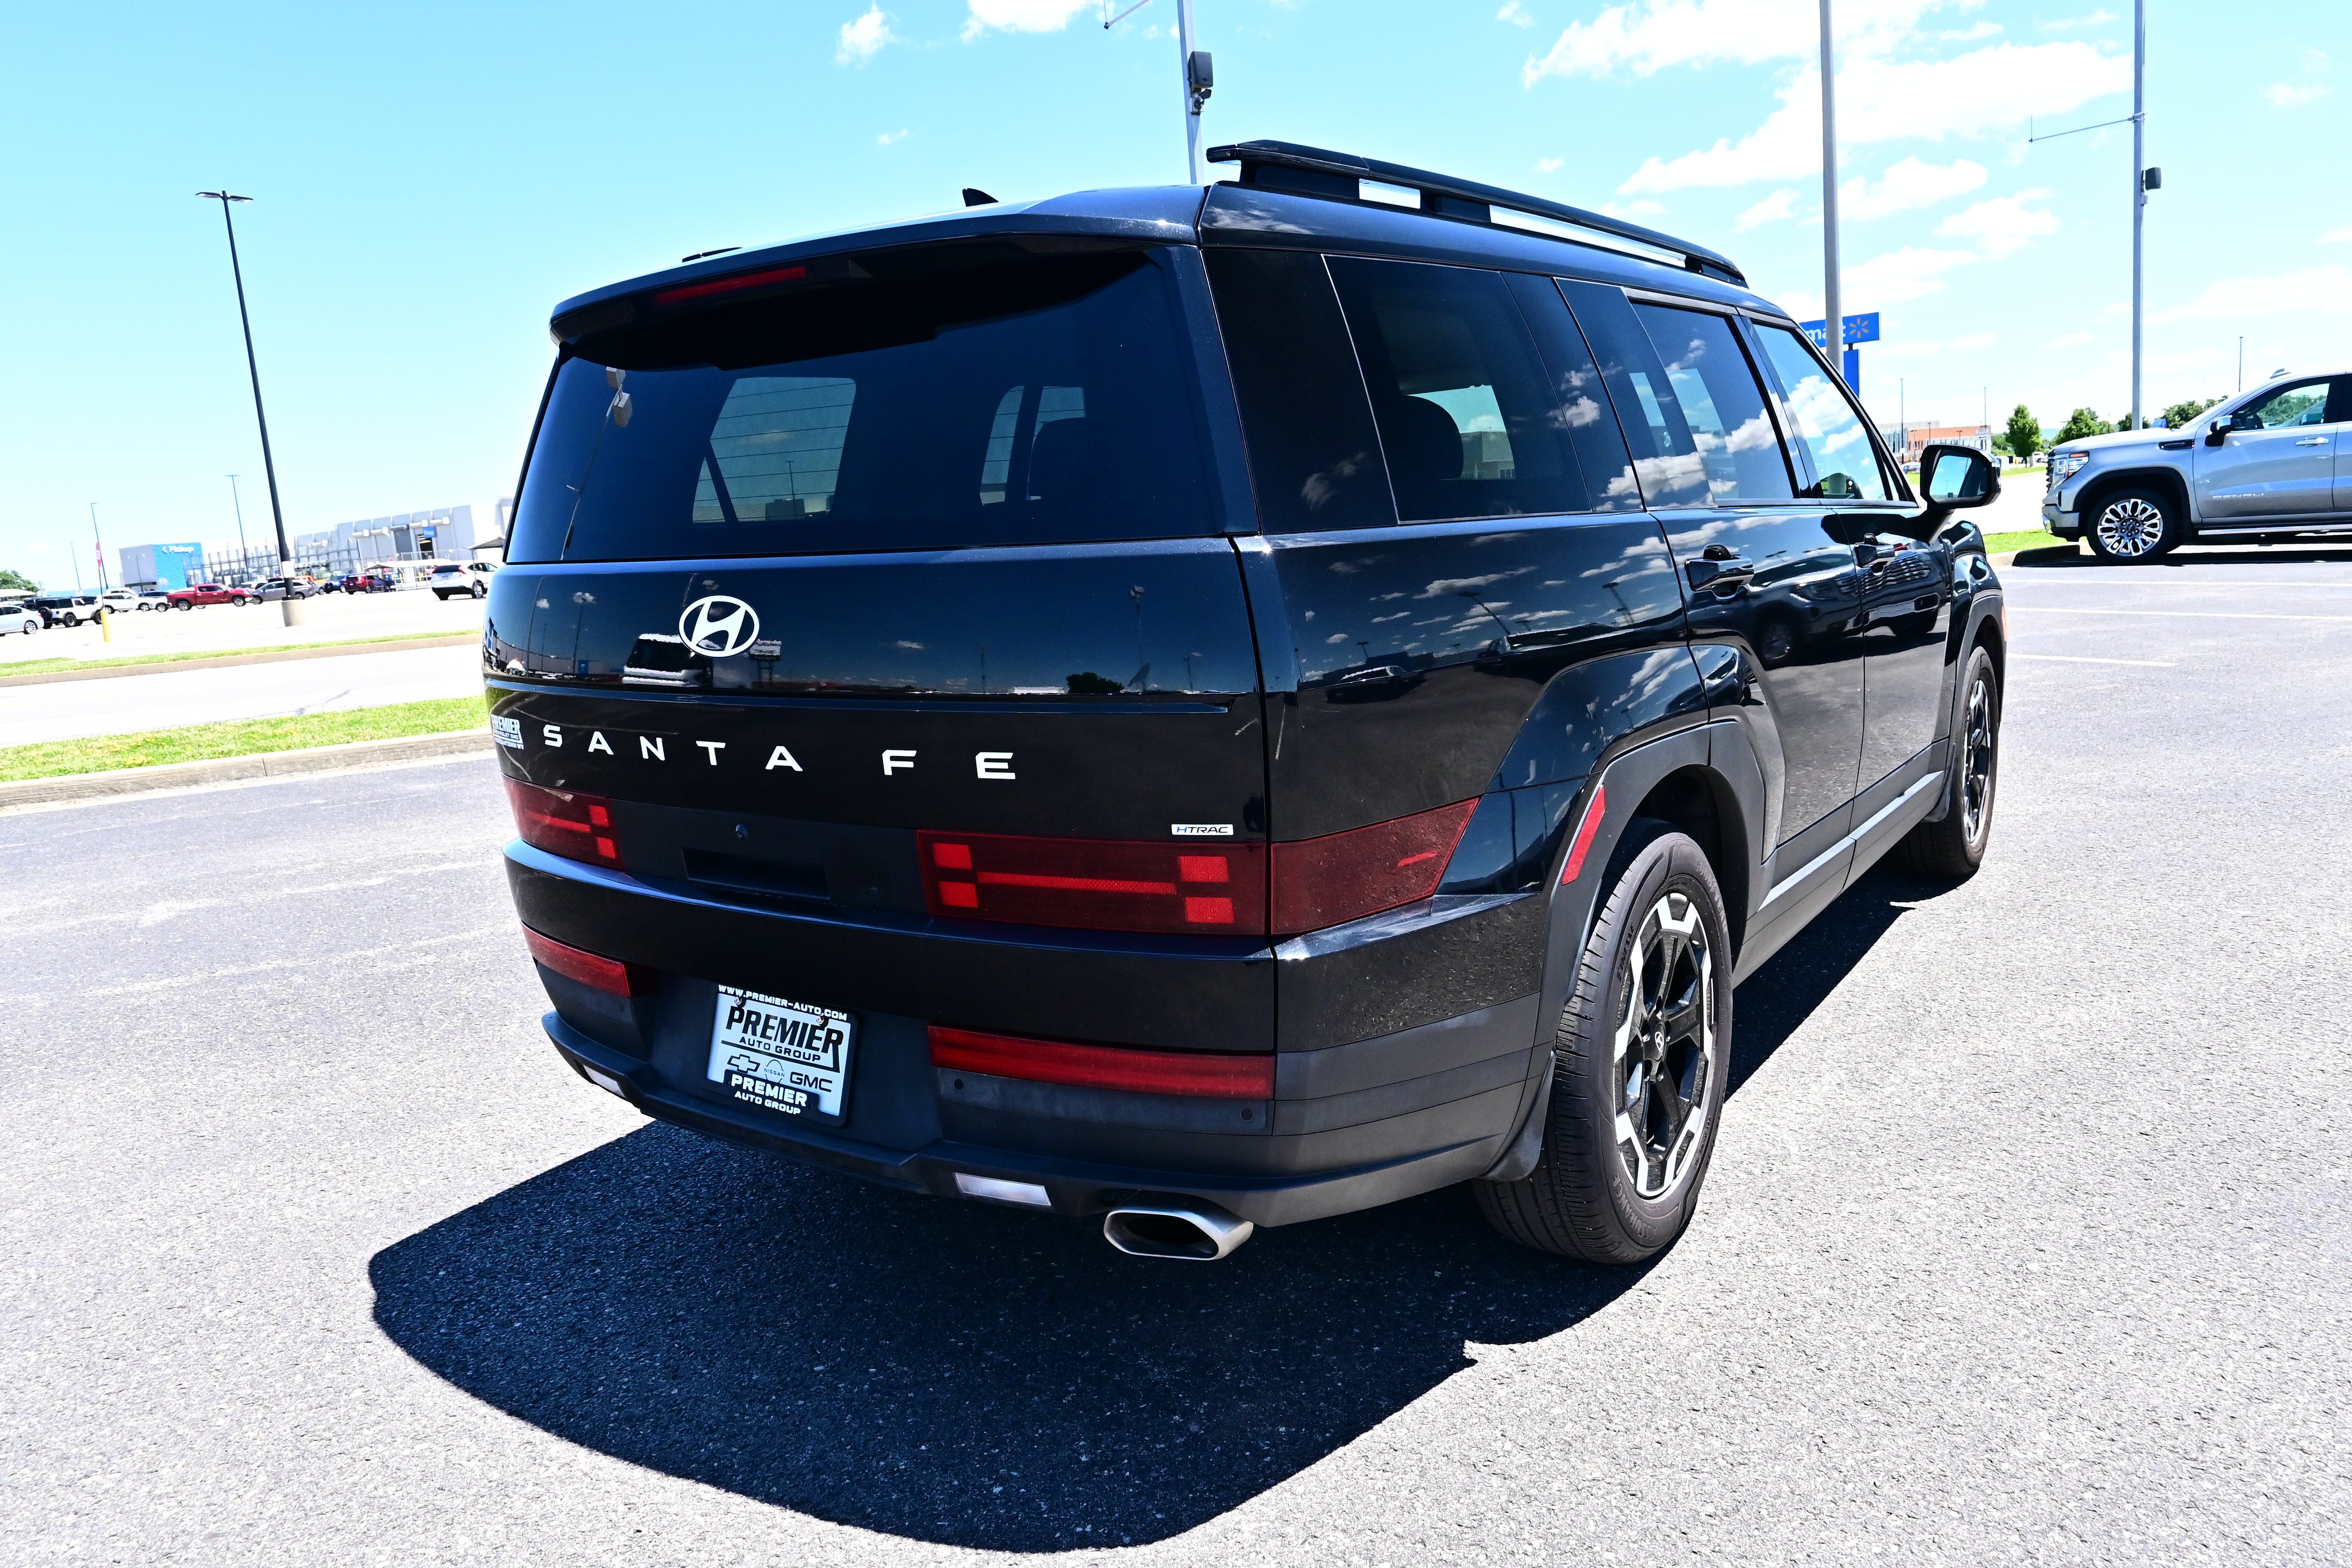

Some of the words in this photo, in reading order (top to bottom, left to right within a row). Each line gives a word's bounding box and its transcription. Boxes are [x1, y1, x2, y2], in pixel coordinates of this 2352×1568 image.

[169, 545, 194, 553] Pickup
[491, 714, 520, 735] PREMIER
[543, 724, 803, 771] SANTA
[882, 749, 1015, 779] FE
[1617, 923, 1634, 982] FINESSE
[719, 985, 847, 1021] WWW.PREMIER-AUTO.COM
[726, 1005, 844, 1054] PREMIER
[739, 1036, 770, 1051] AUTO
[775, 1045, 821, 1062] GROUP
[731, 1074, 807, 1107] PREMIER
[764, 1068, 785, 1077] NISSAN
[790, 1072, 833, 1092] GMC
[735, 1091, 762, 1105] AUTO
[765, 1099, 801, 1115] GROUP
[1613, 1172, 1658, 1240] ASSURANCE
